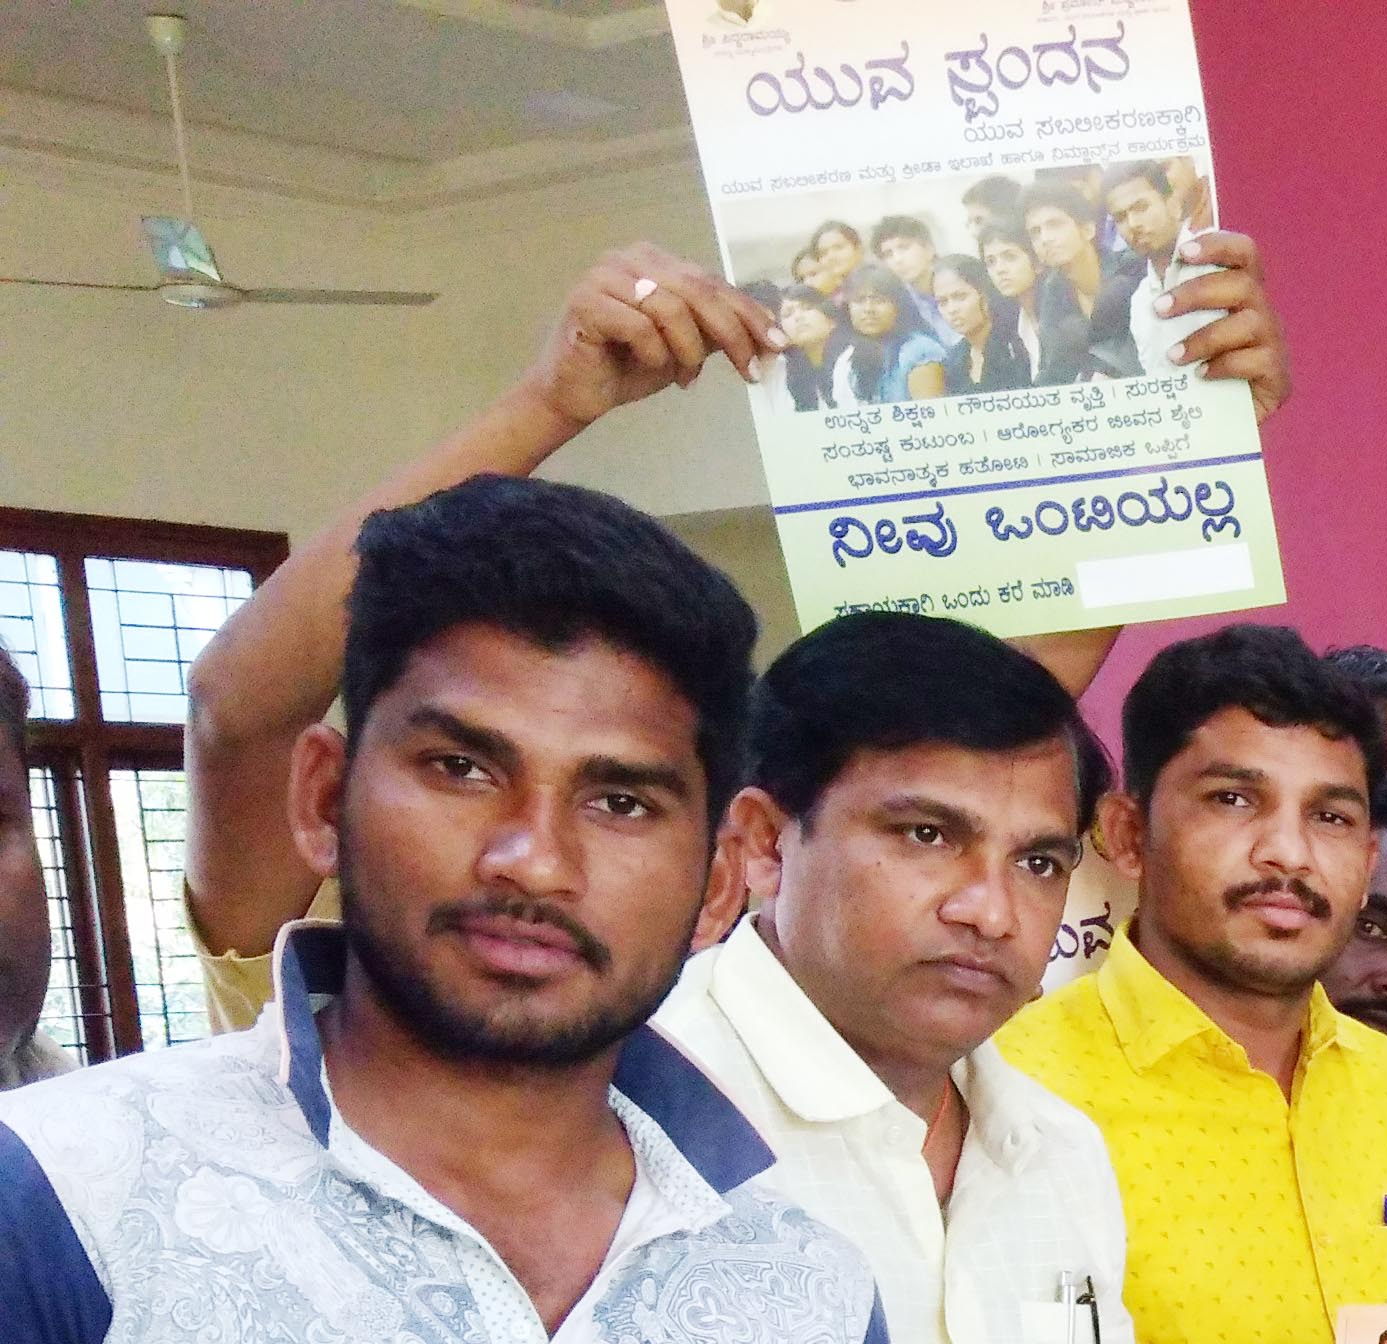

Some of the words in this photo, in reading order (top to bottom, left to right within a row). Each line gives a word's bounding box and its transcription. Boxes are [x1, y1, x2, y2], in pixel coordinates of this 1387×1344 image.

[746, 42, 914, 115] ಯುವ
[944, 19, 1130, 122] ಸ್ಪಂದನ
[829, 502, 959, 564] ನೀವು
[983, 477, 1244, 543] ಒಂಟಿಯಲ್ಲ
